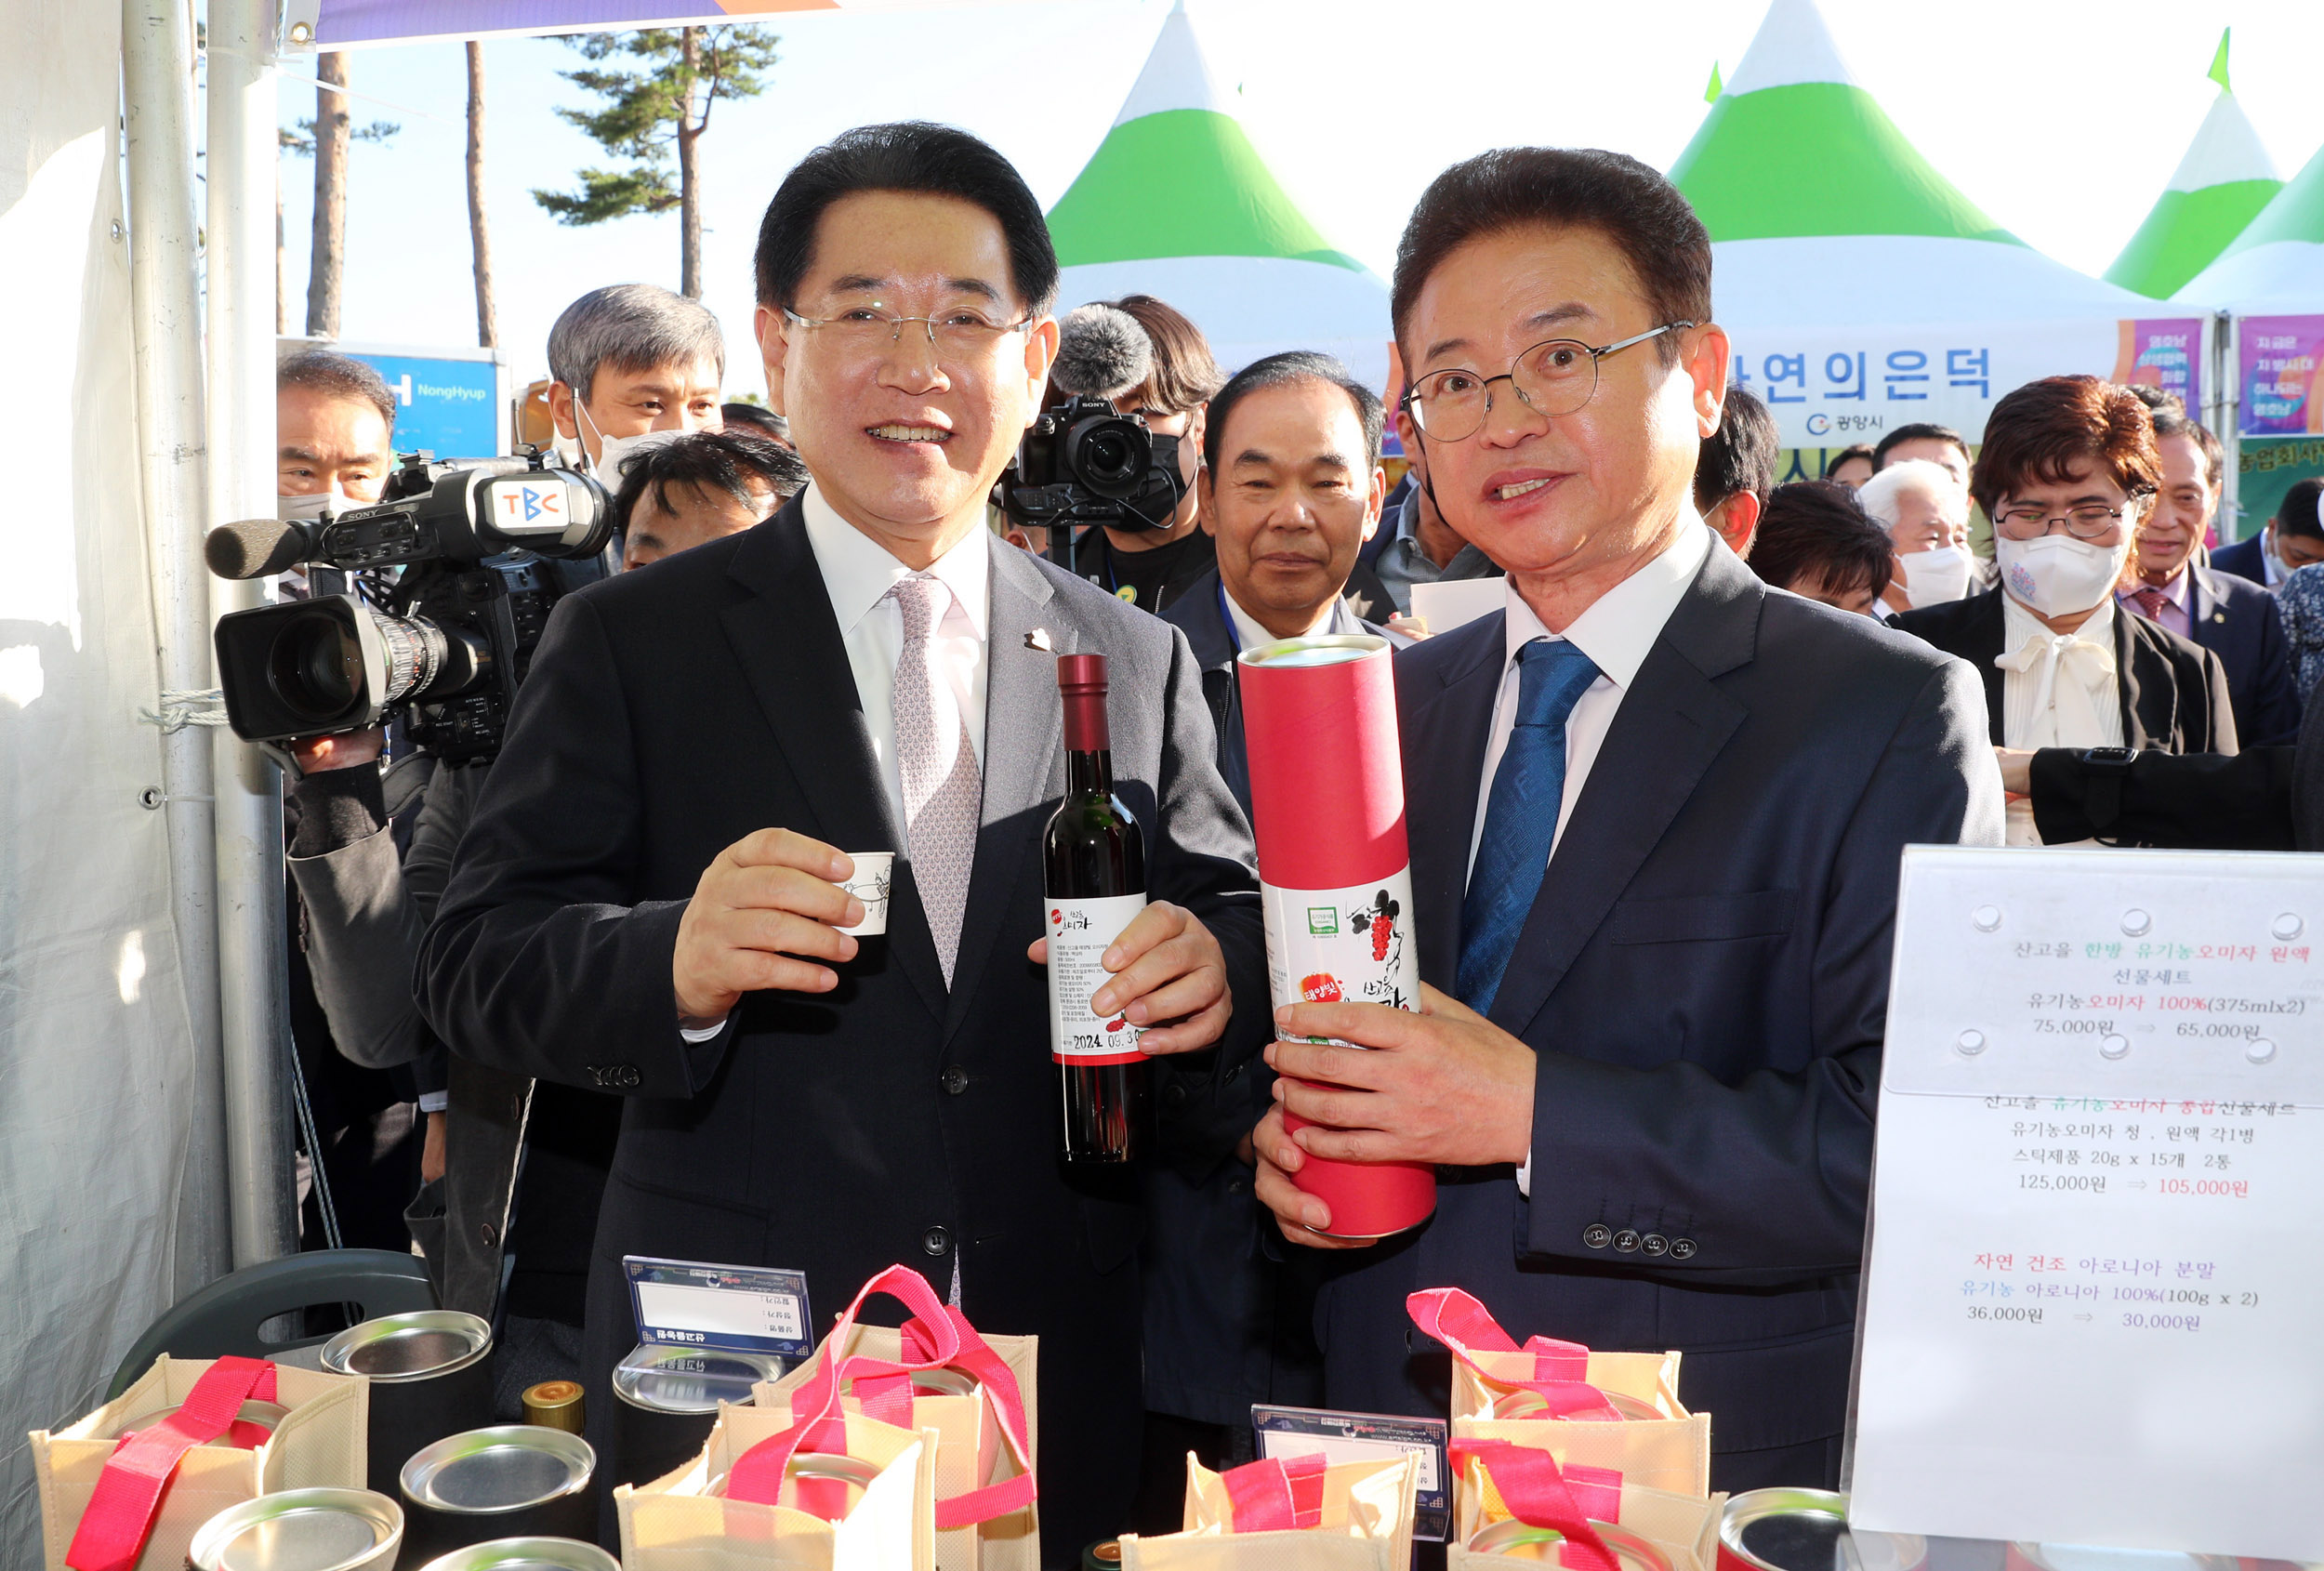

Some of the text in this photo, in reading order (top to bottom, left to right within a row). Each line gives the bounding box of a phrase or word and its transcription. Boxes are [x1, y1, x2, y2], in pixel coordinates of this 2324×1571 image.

[417, 384, 485, 401] NongHyup
[1836, 416, 1884, 430] 광양시
[348, 508, 379, 521] SONY
[503, 486, 560, 521] TBC
[2014, 941, 2310, 964] 산고을 한방 유기농오미자 원액
[2113, 968, 2192, 985] 선물세트
[1304, 982, 1338, 1001] 태양빛
[2027, 992, 2304, 1016] 유기농오미자 100%(375mlx2)
[2011, 1121, 2114, 1140] 유기농오미자
[2166, 1126, 2199, 1142] 원액
[2210, 1128, 2254, 1144] 각1병
[2013, 1148, 2081, 1166] 스틱제품
[2091, 1151, 2120, 1167] 20g
[2150, 1153, 2185, 1168] 15개
[2204, 1155, 2231, 1170] 2통
[1974, 1253, 2216, 1280] 자연 건조 아로니아 분말
[1960, 1280, 2015, 1299] 유기농
[2026, 1283, 2100, 1300] 아로니아
[2240, 1291, 2259, 1308] 2)
[656, 1329, 706, 1342] 산고을농원
